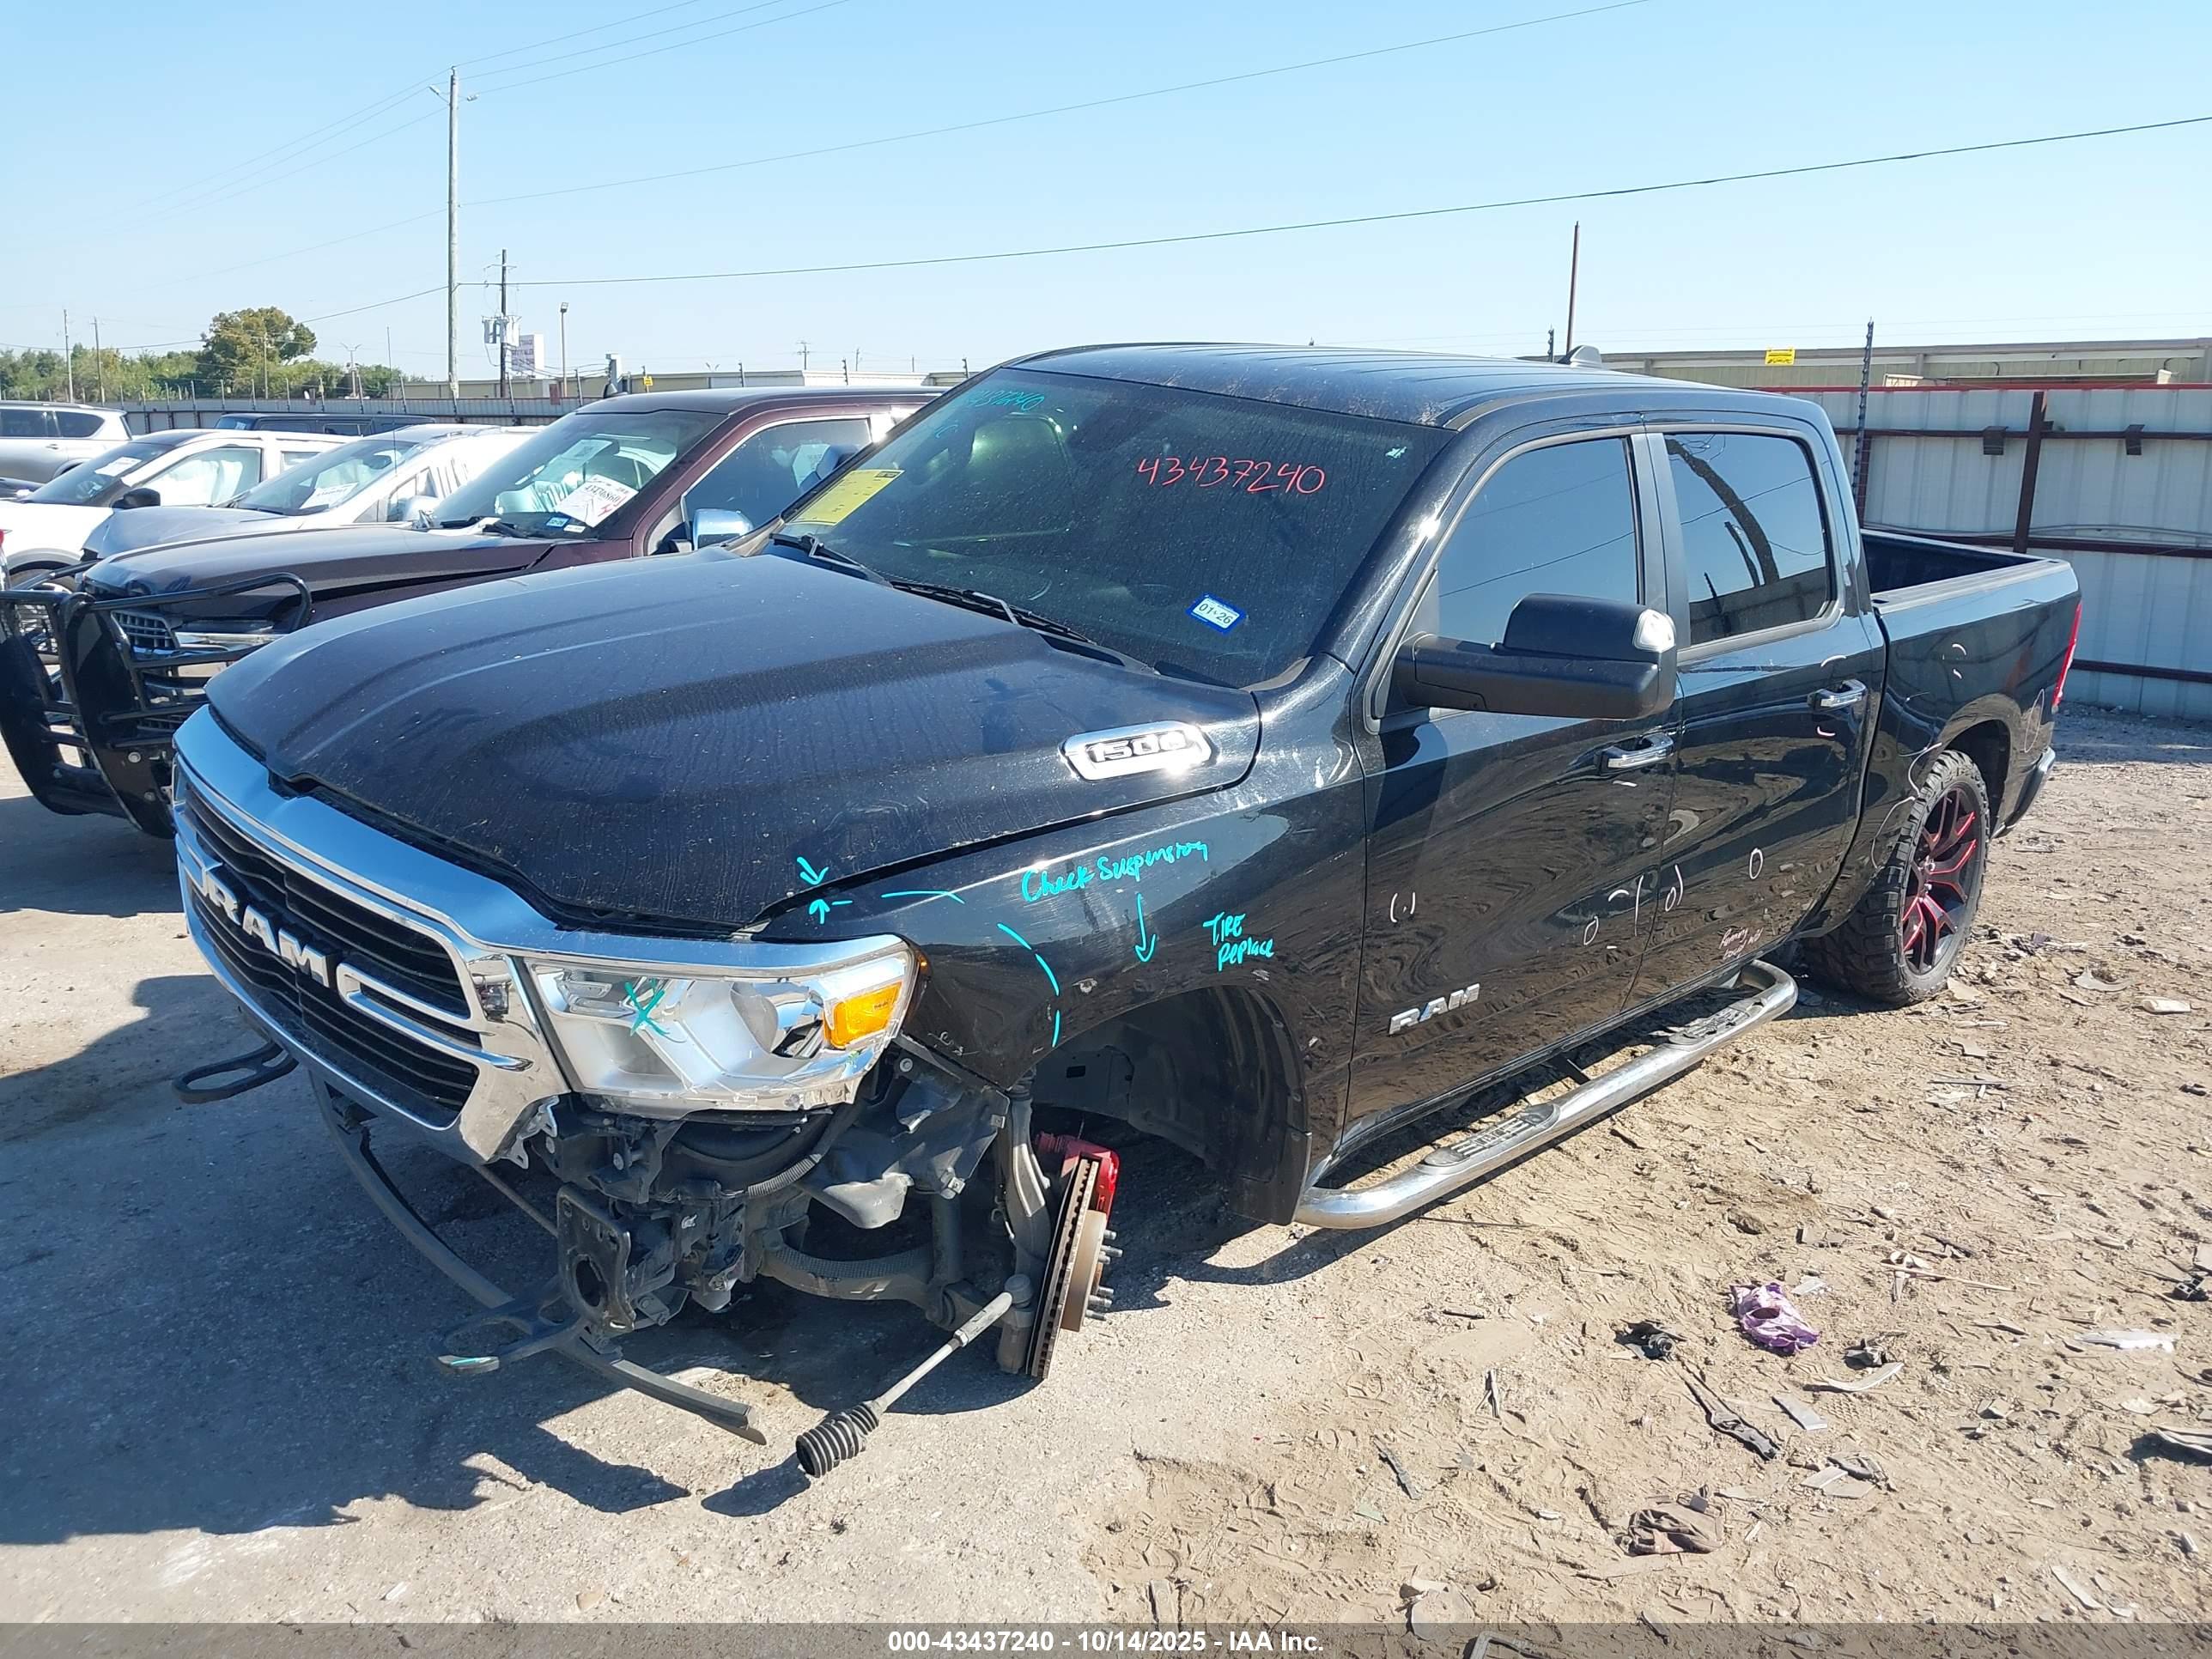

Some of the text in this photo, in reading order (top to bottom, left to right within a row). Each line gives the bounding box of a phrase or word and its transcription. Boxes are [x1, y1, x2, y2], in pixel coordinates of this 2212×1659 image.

[1137, 456, 1326, 494] 43437240
[1087, 729, 1192, 763] 1500
[1022, 866, 1096, 902] Check
[204, 867, 331, 988] RAM
[1389, 982, 1480, 1036] RAM
